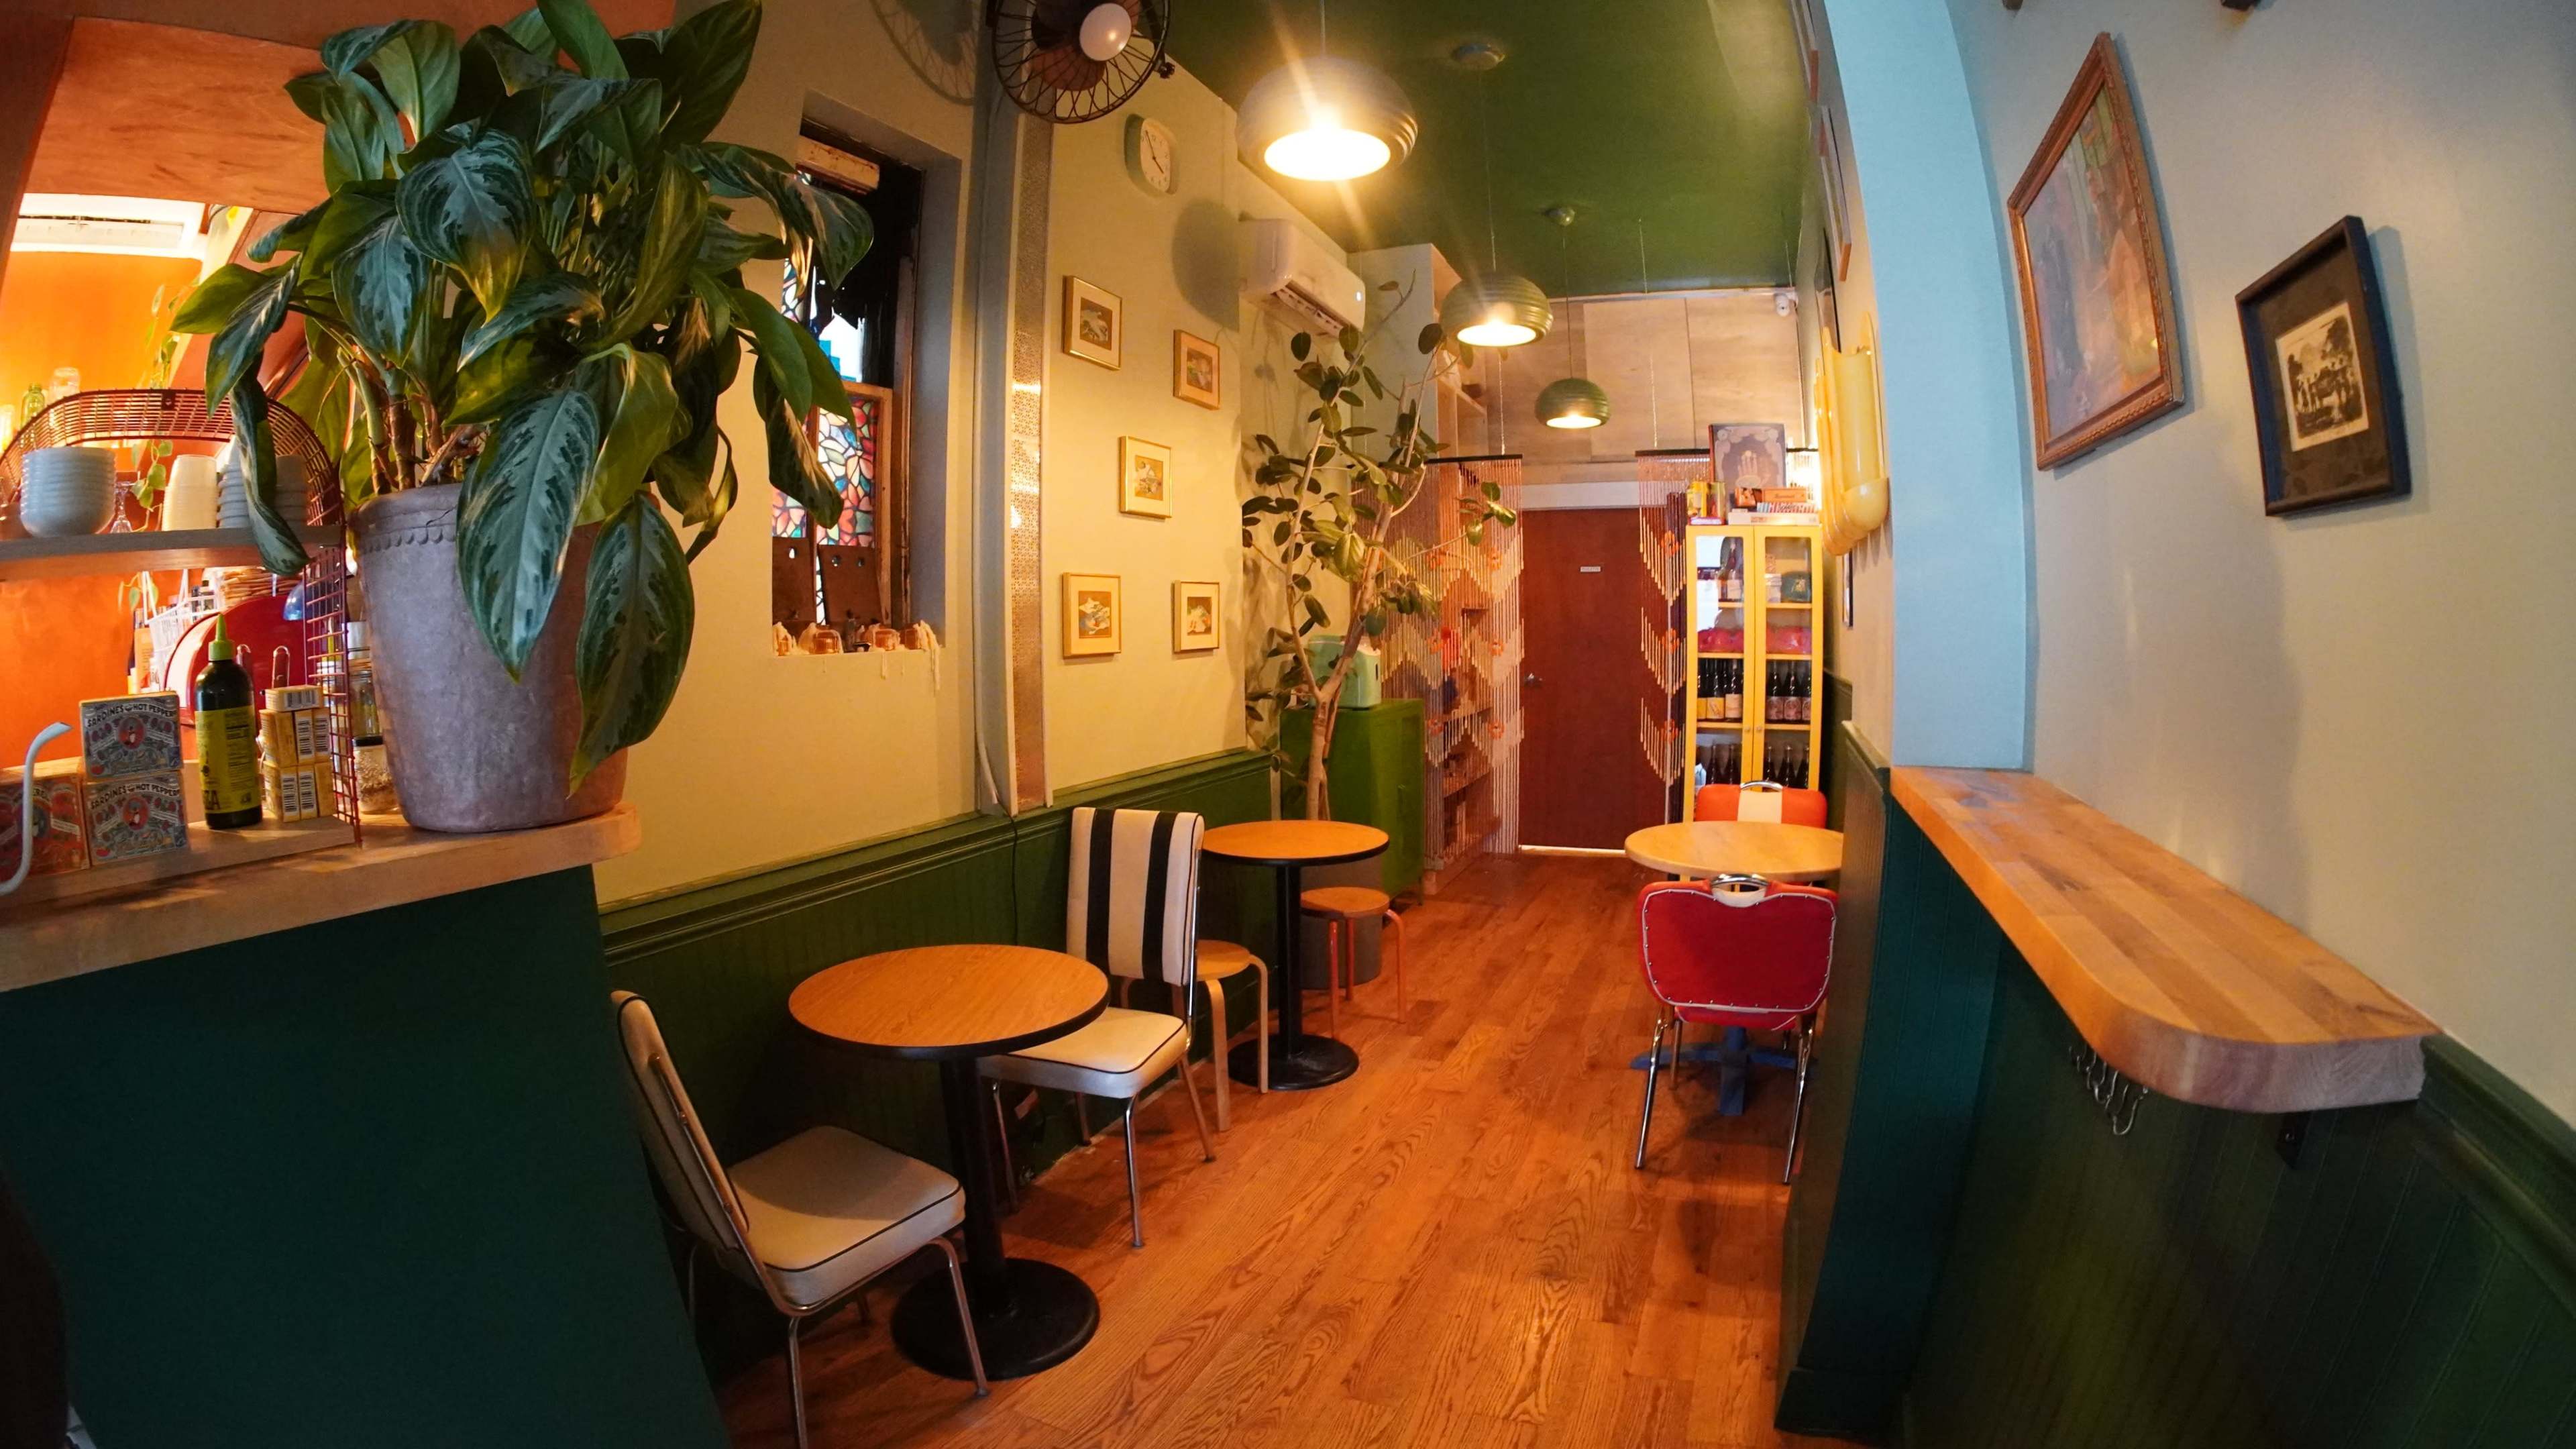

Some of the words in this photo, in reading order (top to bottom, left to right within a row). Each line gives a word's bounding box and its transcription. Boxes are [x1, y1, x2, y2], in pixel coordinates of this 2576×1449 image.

[87, 705, 124, 727] SARDINES
[91, 785, 126, 809] SARDINES
[136, 783, 150, 791] HOT
